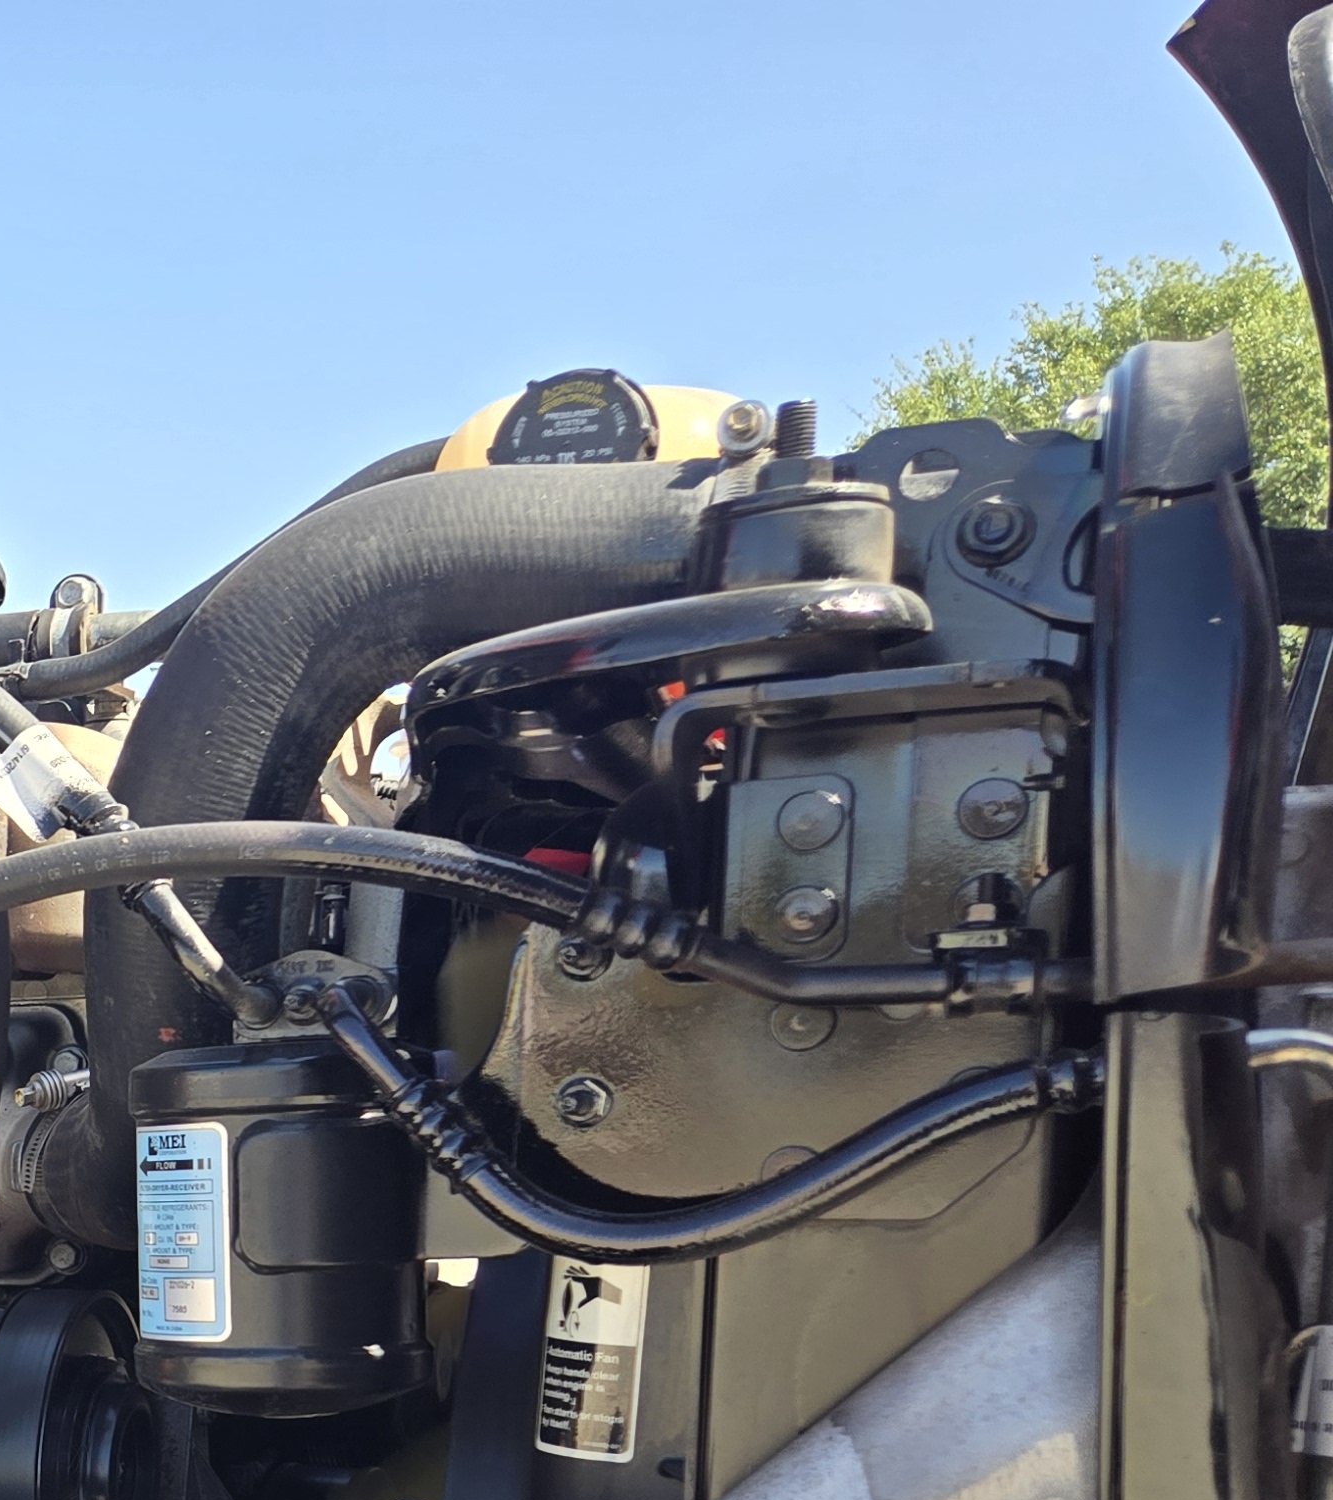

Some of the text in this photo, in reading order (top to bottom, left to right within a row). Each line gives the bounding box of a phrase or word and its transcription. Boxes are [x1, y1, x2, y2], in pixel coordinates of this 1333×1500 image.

[158, 1134, 187, 1150] MEI
[155, 1162, 177, 1170] FLOW
[594, 1351, 620, 1364] Fan
[590, 1371, 620, 1382] clear
[592, 1413, 625, 1426] stops
